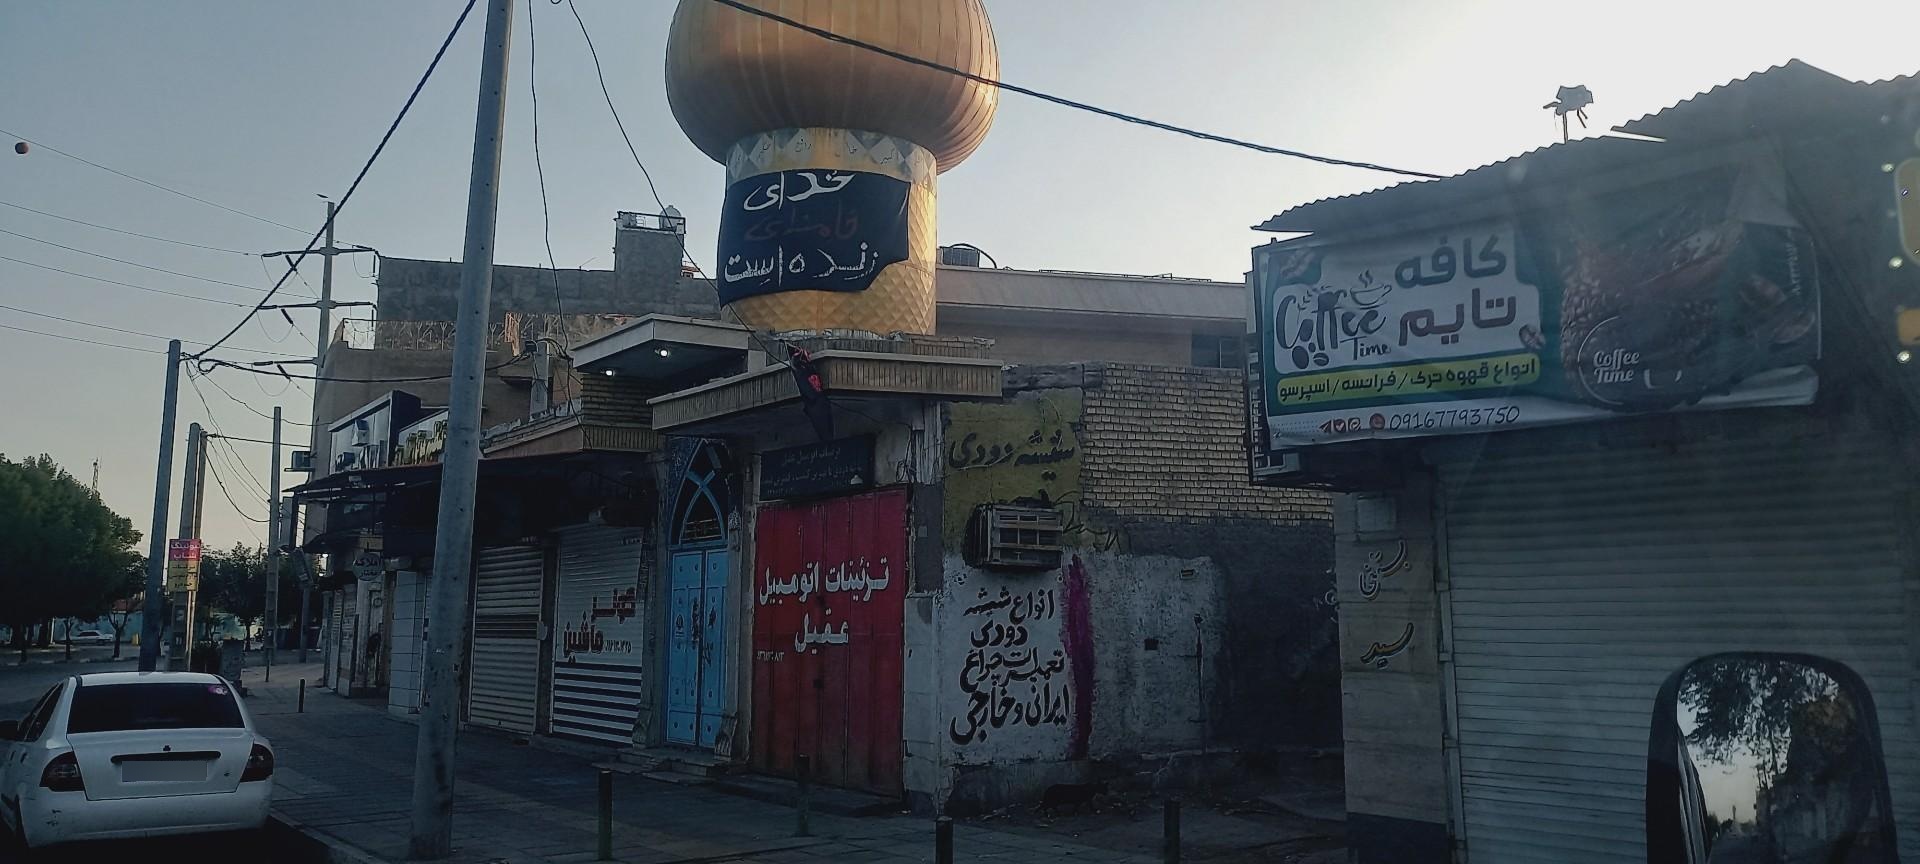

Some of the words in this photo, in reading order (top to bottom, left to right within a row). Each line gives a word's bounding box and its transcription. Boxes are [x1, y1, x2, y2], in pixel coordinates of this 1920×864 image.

[743, 170, 856, 211] خدای
[723, 243, 784, 287] است
[788, 242, 879, 281] زنده
[1395, 235, 1507, 288] کافه
[1398, 288, 1516, 346] تایم
[1340, 335, 1391, 361] Time
[1593, 348, 1641, 369] Coffee
[1446, 362, 1489, 386] قهوه
[1493, 358, 1536, 385] انواع
[1593, 366, 1634, 385] Time
[1388, 404, 1521, 431] 09167793750
[949, 431, 1014, 469] دودی
[759, 561, 820, 606] اتومبیل
[1009, 588, 1055, 625] انواع
[563, 610, 604, 665] ماشین
[794, 608, 850, 655] عقیل
[970, 619, 1029, 649] دودی
[1000, 646, 1066, 688] تعمیرات
[950, 686, 1017, 746] خارجی
[1011, 702, 1025, 726] و
[1024, 683, 1071, 727] ایرانی
